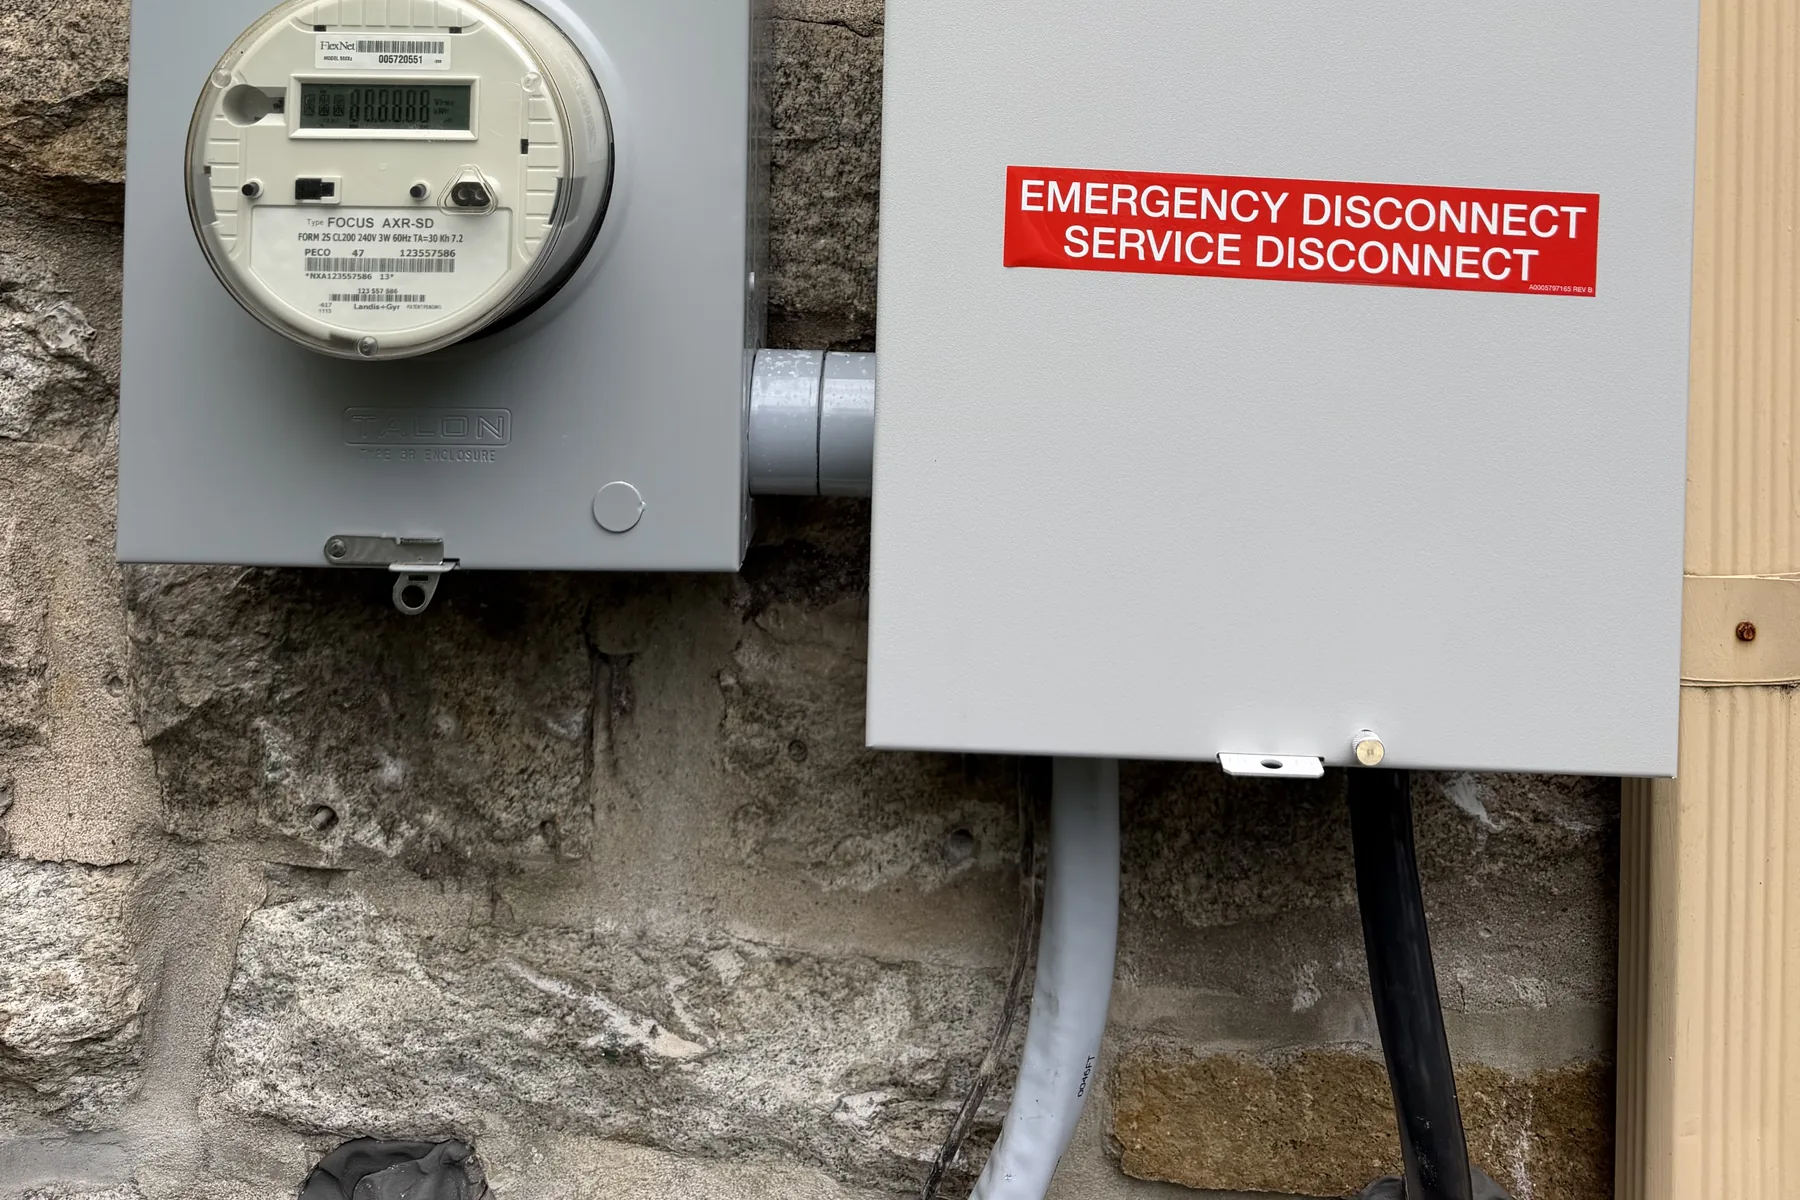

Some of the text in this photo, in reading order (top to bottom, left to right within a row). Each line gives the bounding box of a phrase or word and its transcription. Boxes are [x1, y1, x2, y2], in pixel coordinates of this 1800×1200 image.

[320, 40, 356, 50] FlexNet
[378, 54, 422, 64] 005720551
[1020, 179, 1586, 240] EMERGENCY DISCONNECT
[306, 217, 434, 229] Type FOCUS AXR-SD
[298, 232, 463, 242] FORM 2S CL200 240V 3W 60Hz TA=30 Kh 7.2
[304, 248, 331, 256] PECO
[400, 249, 456, 257] 123557586
[1064, 224, 1539, 283] SERVICE DISCONNECT
[1528, 284, 1572, 292] A0005797165
[352, 414, 504, 440] TALON
[425, 450, 496, 463] ENCLOSURE
